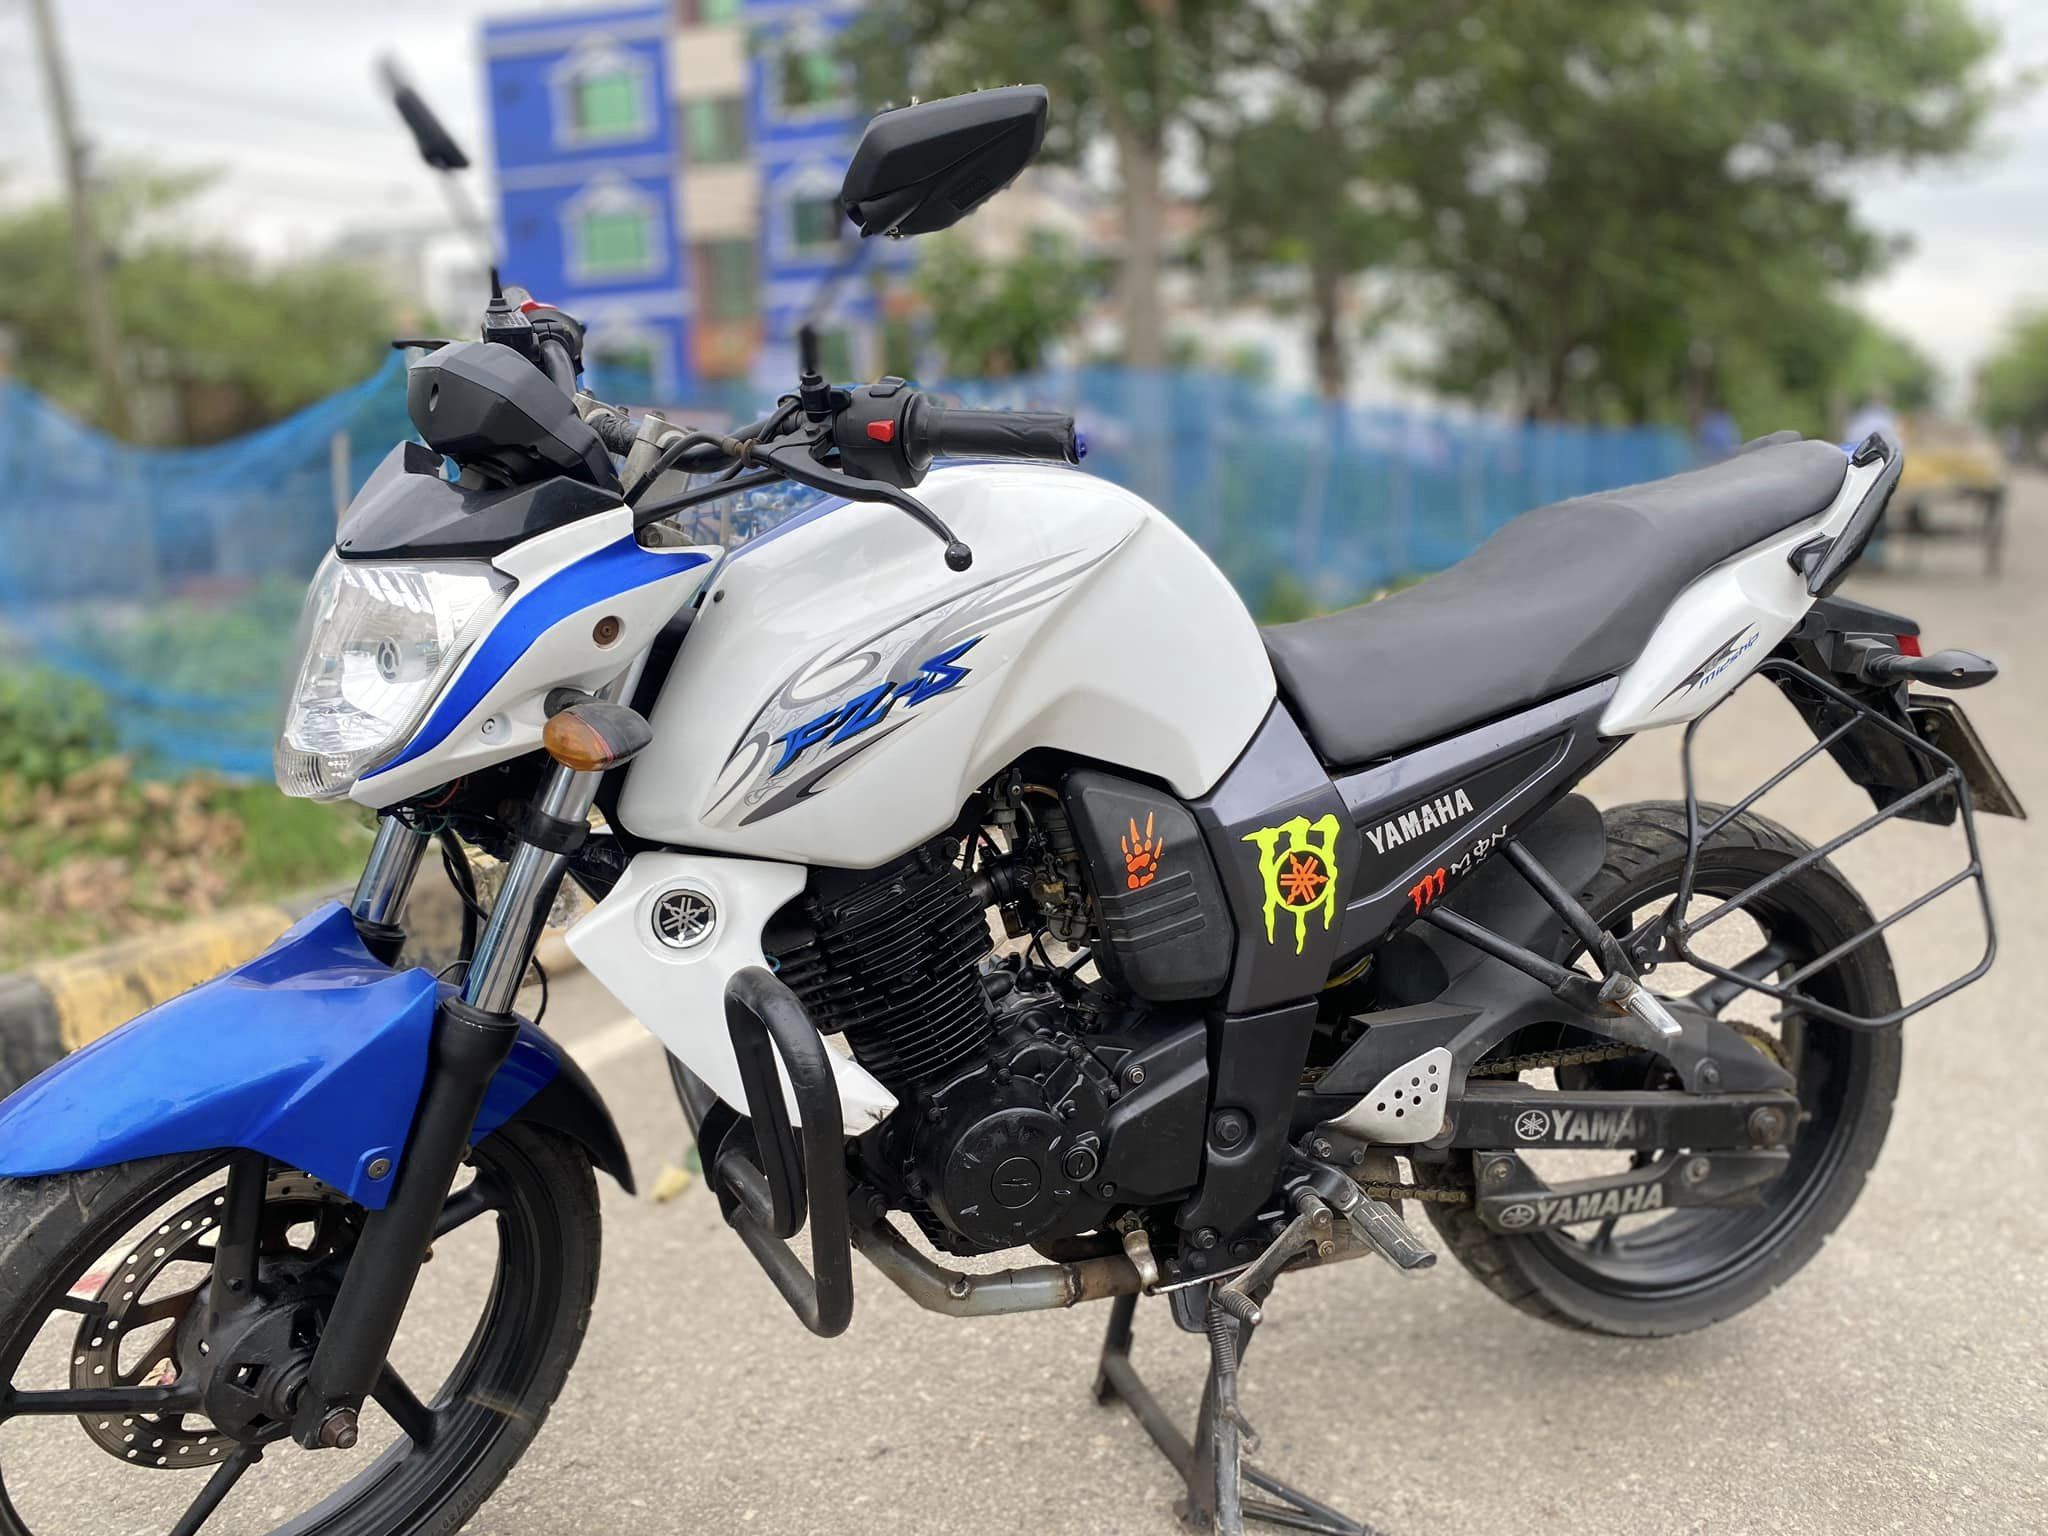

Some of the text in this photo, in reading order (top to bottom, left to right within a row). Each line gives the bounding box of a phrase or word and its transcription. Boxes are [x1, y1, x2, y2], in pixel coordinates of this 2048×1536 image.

[1366, 788, 1474, 855] YAMAHA
[1551, 1109, 1646, 1142] YAMA
[1536, 1183, 1664, 1227] YAMAHA
